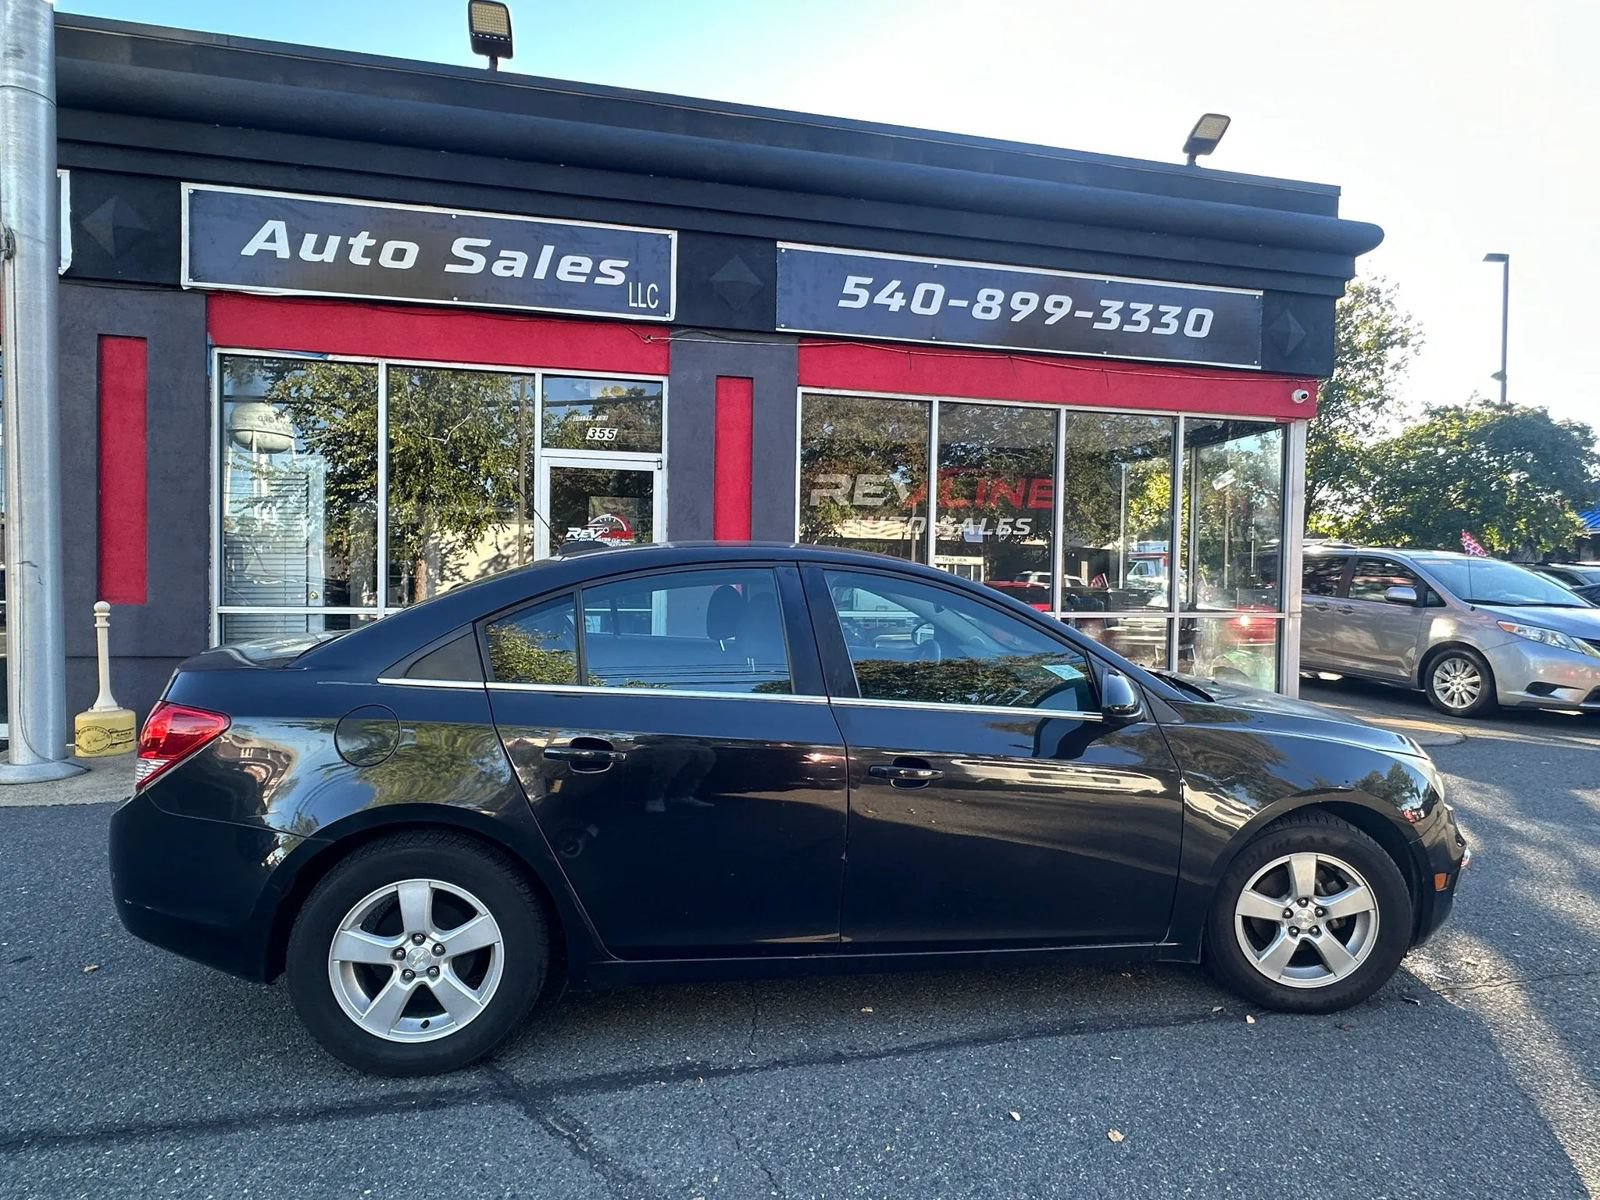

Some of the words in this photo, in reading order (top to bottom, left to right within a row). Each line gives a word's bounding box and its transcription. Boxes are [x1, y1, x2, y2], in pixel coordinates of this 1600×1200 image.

[240, 219, 420, 270] Auto
[444, 236, 630, 286] Sales
[628, 281, 659, 309] LLC
[837, 275, 1214, 339] 540-899-3330
[588, 428, 616, 440] 355
